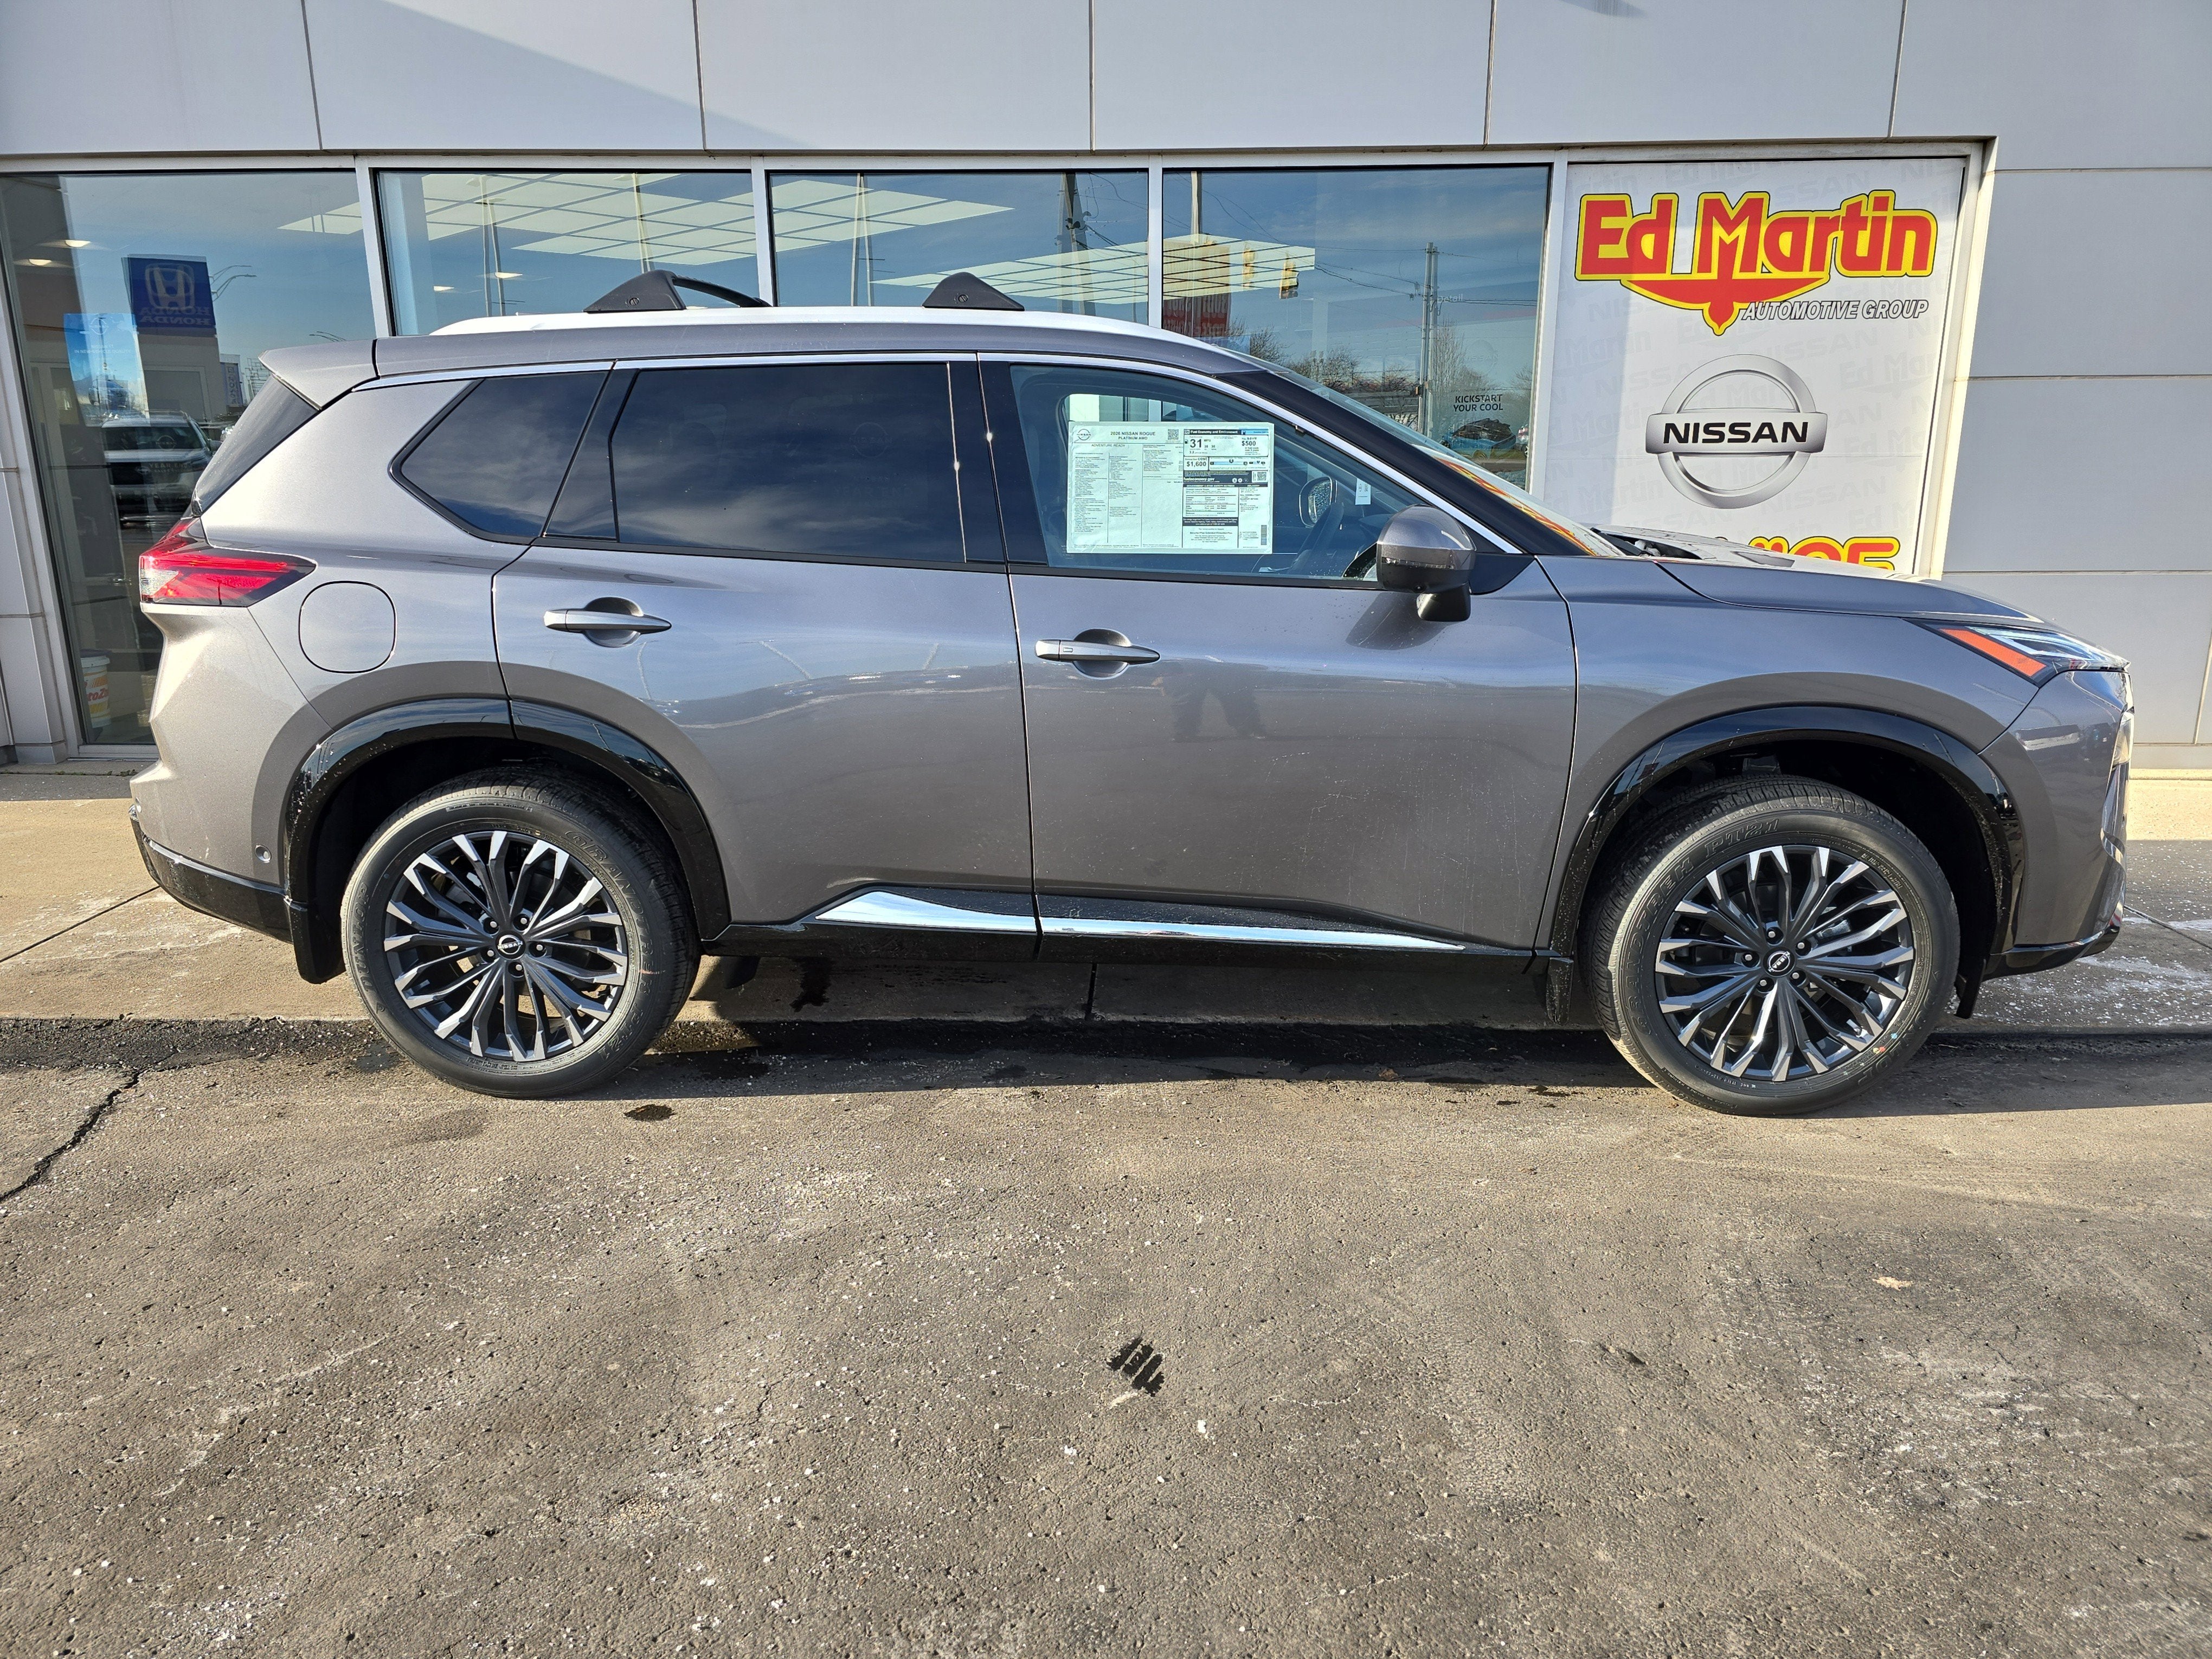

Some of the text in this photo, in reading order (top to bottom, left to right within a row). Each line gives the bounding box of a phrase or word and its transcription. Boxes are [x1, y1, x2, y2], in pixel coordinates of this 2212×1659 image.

[1575, 190, 1938, 281] Ed Martin
[1741, 299, 1929, 321] AUTOMOTIVE GROUP
[1453, 403, 1503, 412] YOUR COOL
[1455, 394, 1503, 403] KICKSTART
[1190, 439, 1202, 448] 31
[1663, 422, 1809, 445] NISSAN
[1705, 819, 1779, 858] PT21
[352, 882, 373, 992] DUNLOP
[497, 941, 523, 949] NISSAN
[1768, 951, 1790, 972] NISSAN
[598, 1002, 644, 1060] PT21
